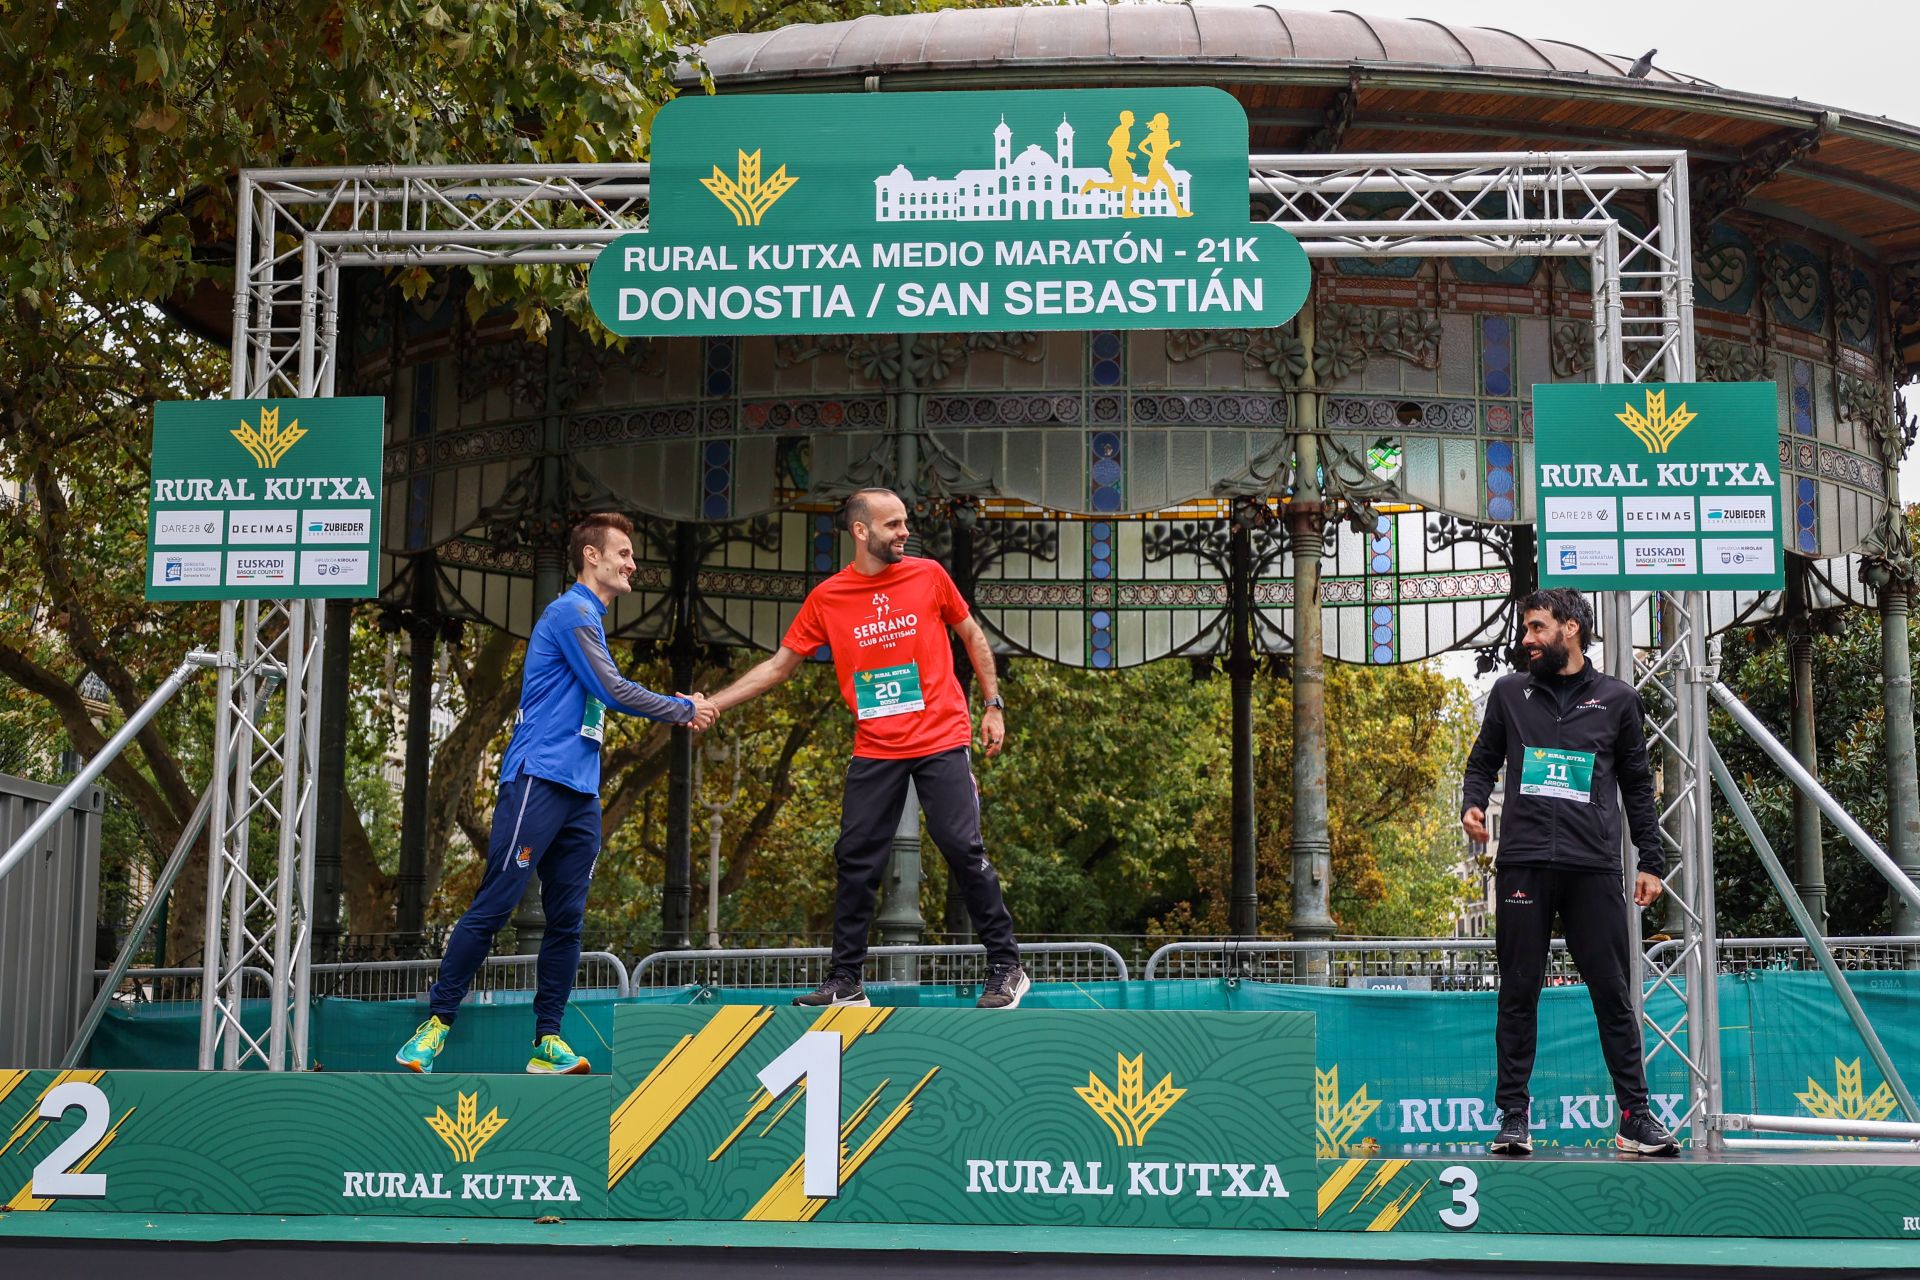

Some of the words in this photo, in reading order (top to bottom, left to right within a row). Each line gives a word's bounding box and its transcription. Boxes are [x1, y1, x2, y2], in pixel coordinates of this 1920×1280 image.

[623, 245, 738, 272] RURAL
[748, 243, 862, 270] KUTXA
[873, 241, 984, 268] MEDIO
[995, 231, 1164, 266] MARATÓN
[1197, 237, 1260, 263] 21K
[617, 283, 854, 321] DONOSTIA
[866, 283, 887, 318] /
[896, 282, 989, 317] SAN
[1004, 268, 1264, 316] SEBASTIÁN
[1540, 463, 1648, 487] RURAL
[1656, 462, 1775, 486] KUTXA
[154, 478, 255, 501] RURAL
[264, 477, 375, 500] KUTXA
[1627, 512, 1691, 521] DECIMAS
[1723, 509, 1766, 519] ZUBIEDER
[232, 524, 293, 533] DECIMAS
[324, 522, 364, 532] ZUBIEDER
[237, 559, 284, 568] EUSKADI
[1635, 547, 1685, 556] EUSKADI
[853, 613, 918, 639] SERRANO
[859, 637, 878, 648] CLUB
[878, 628, 917, 643] ATLETISMO
[874, 681, 901, 700] 20
[1543, 779, 1570, 788] ARROYO
[1546, 763, 1568, 781] 11
[756, 1030, 841, 1198] 1
[1559, 1093, 1691, 1128] KUX
[31, 1081, 110, 1197] 2
[342, 1171, 452, 1199] RURAL
[461, 1174, 581, 1201] KUTXA
[966, 1159, 1114, 1195] RURAL
[1127, 1162, 1290, 1198] KUTXA
[1438, 1166, 1480, 1228] 3
